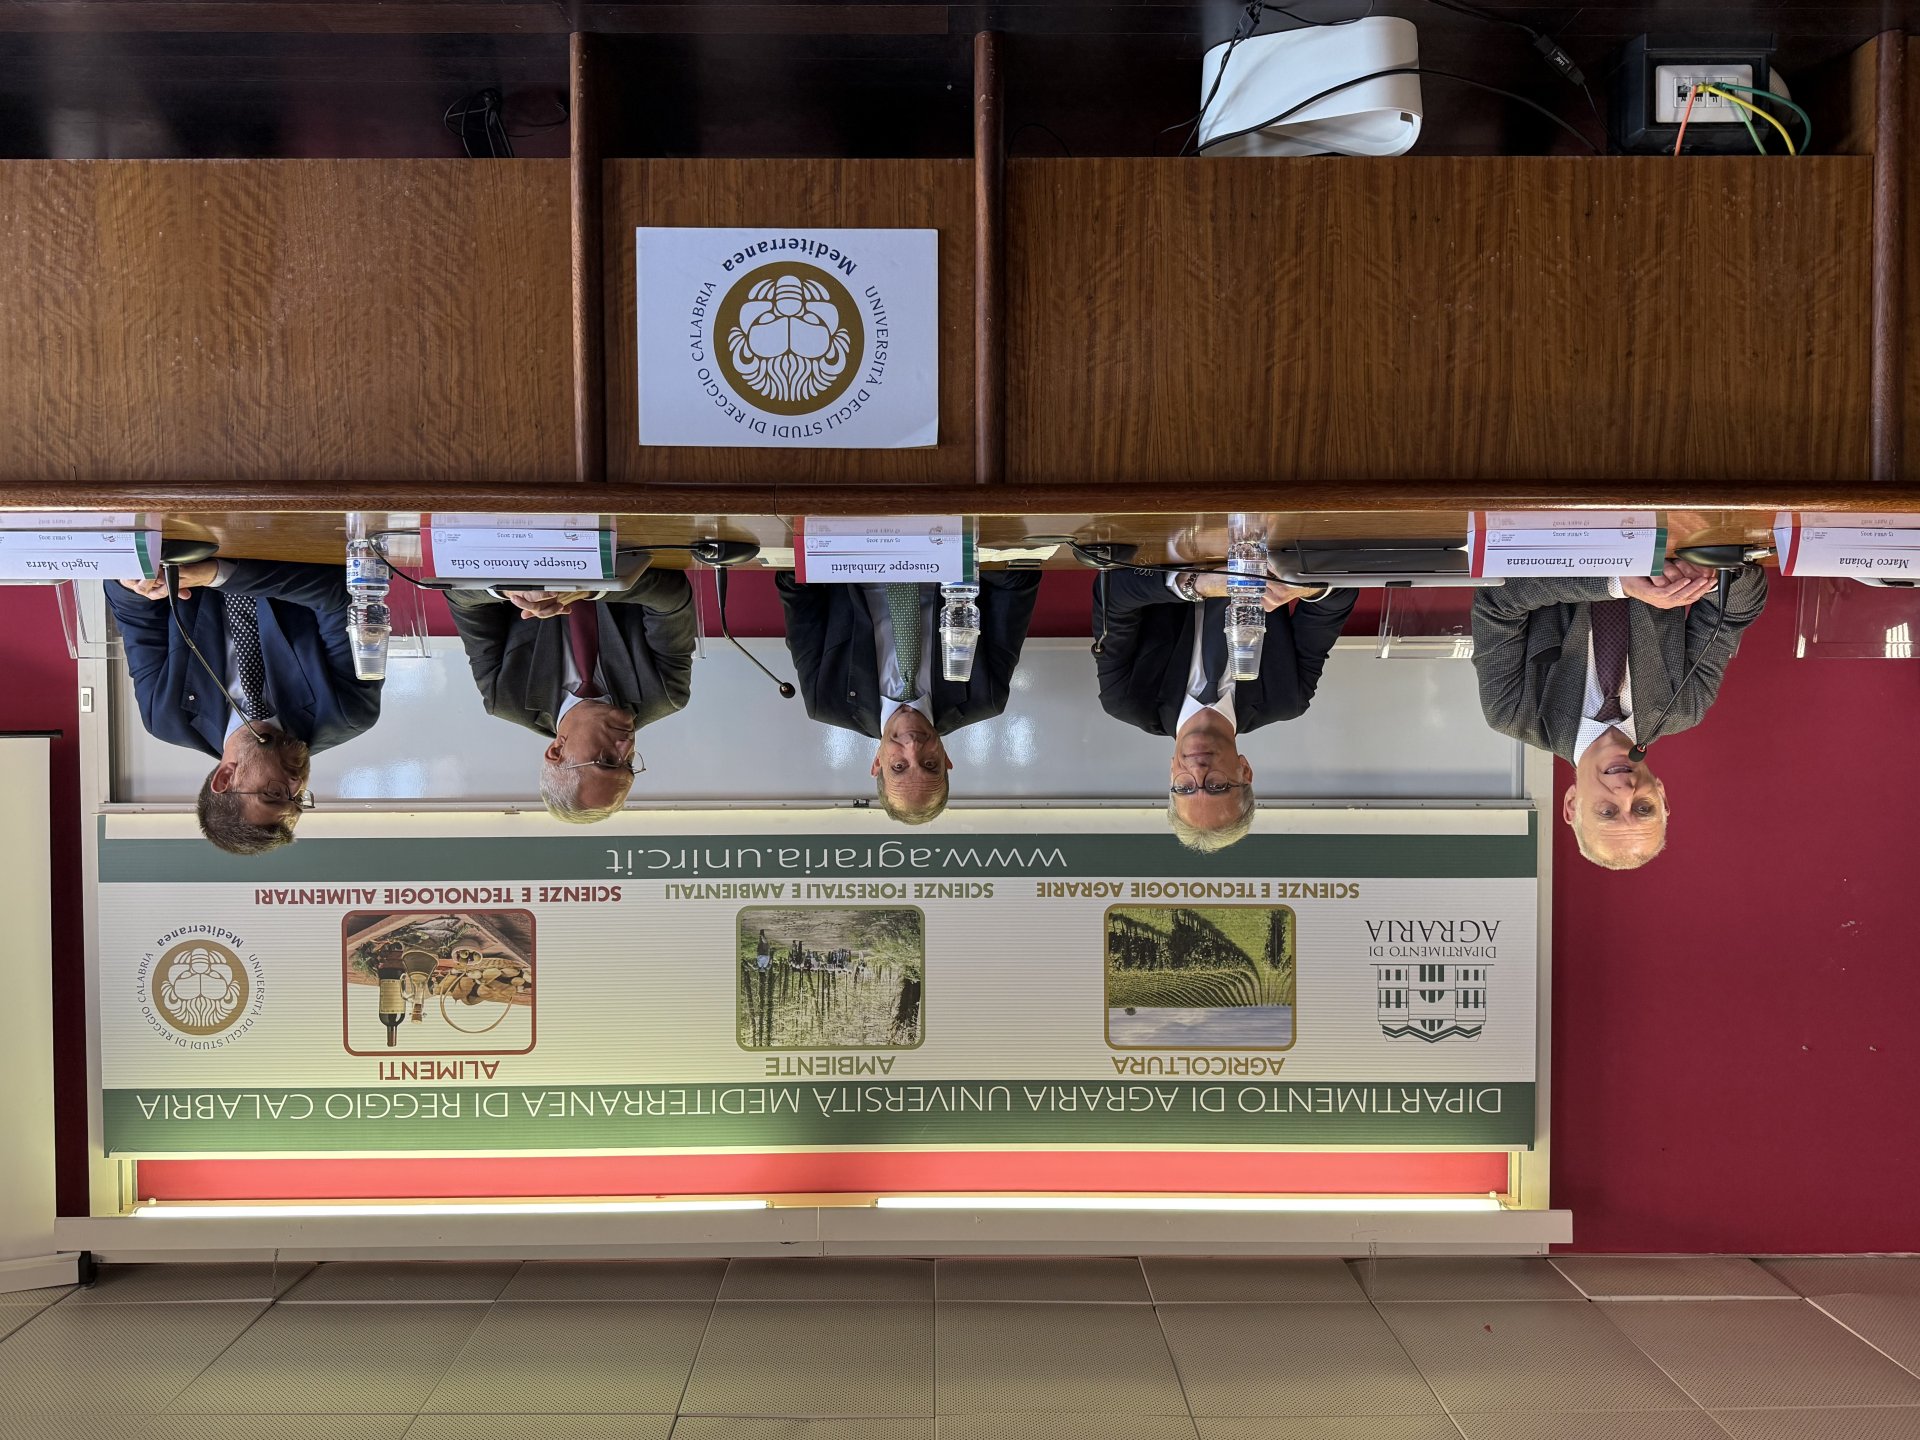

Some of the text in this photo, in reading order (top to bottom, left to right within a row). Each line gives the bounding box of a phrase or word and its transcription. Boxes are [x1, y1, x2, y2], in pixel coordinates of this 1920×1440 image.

[720, 238, 858, 276] Mediterranea
[689, 280, 888, 438] UNIVERSITÀ DEGLI STUDI DI REGGIO CALABRIA
[25, 558, 99, 571] Angelo Marra
[450, 556, 587, 570] Giuseppe Antonio Sofia
[830, 561, 940, 574] Giuseppe Zimbalatti
[1506, 557, 1634, 568] Antonino Tramontana
[1839, 557, 1910, 569] Marco Poiana
[605, 840, 1068, 876] www.agraria.unirc.it
[254, 885, 622, 905] SCIENZE E TECNOLOGIE ALIMENTARI
[664, 882, 994, 900] SCIENZE FORESTALI E AMBIENTALI
[1036, 881, 1360, 899] SCIENZE E TECNOLOGIE AGRARIE
[156, 924, 244, 948] Mediterranea
[1364, 919, 1501, 942] AGRARIA
[1368, 946, 1384, 958] DI
[136, 952, 264, 1050] UNIVERSITÀ DEGLI STUDI DI REGGIO CALABRIA
[378, 1060, 500, 1080] ALIMENTI
[765, 1056, 896, 1077] AMBIENTE
[1111, 1056, 1286, 1076] AGRICOLTURA
[136, 1086, 1502, 1121] DIPARTIMENTO DI AGRARIA UNIVERSITÀ MEDITERRANEA DI REGGIO CALABRIA
